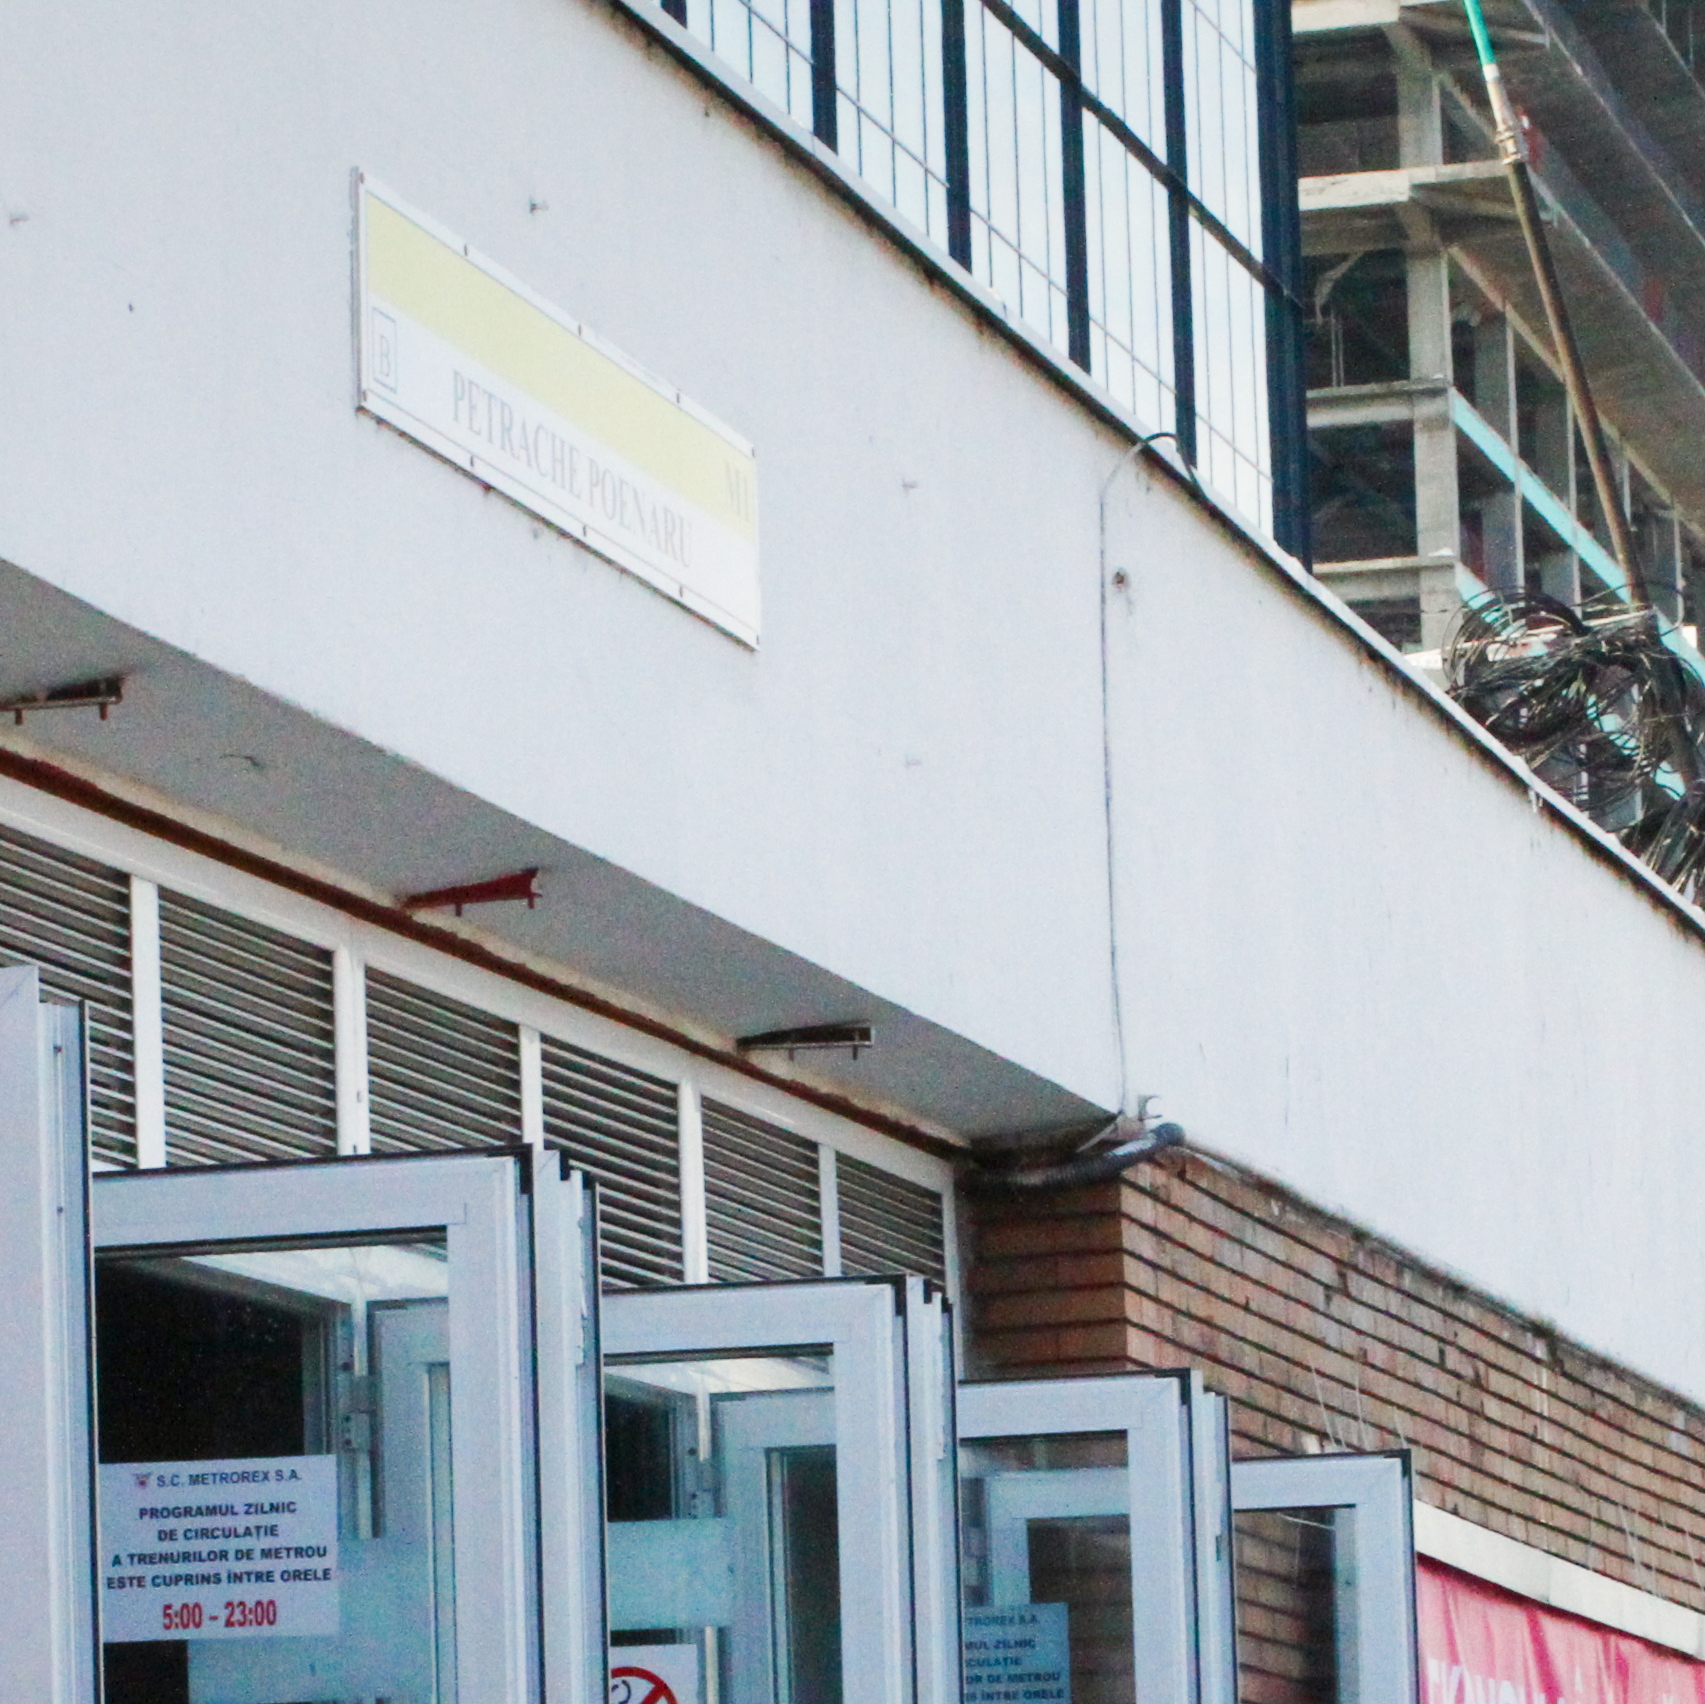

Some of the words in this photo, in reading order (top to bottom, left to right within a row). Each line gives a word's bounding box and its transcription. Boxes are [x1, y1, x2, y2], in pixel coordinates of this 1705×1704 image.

[453, 367, 582, 500] PETRACHE
[588, 457, 693, 569] POENARU
[188, 1470, 271, 1487] METROREX
[138, 1504, 239, 1520] PROGRAMUL
[243, 1501, 298, 1515] ZILNIC
[157, 1528, 178, 1541] DE
[111, 1554, 123, 1567] A
[126, 1549, 230, 1566] TRENURILOR
[234, 1548, 255, 1561] DE
[260, 1545, 328, 1560] METROU
[106, 1576, 146, 1590] ESTE
[151, 1572, 222, 1588] CUPRINS
[280, 1567, 332, 1582] ORELE
[162, 1602, 204, 1631] 5:00
[223, 1599, 278, 1629] 23:00
